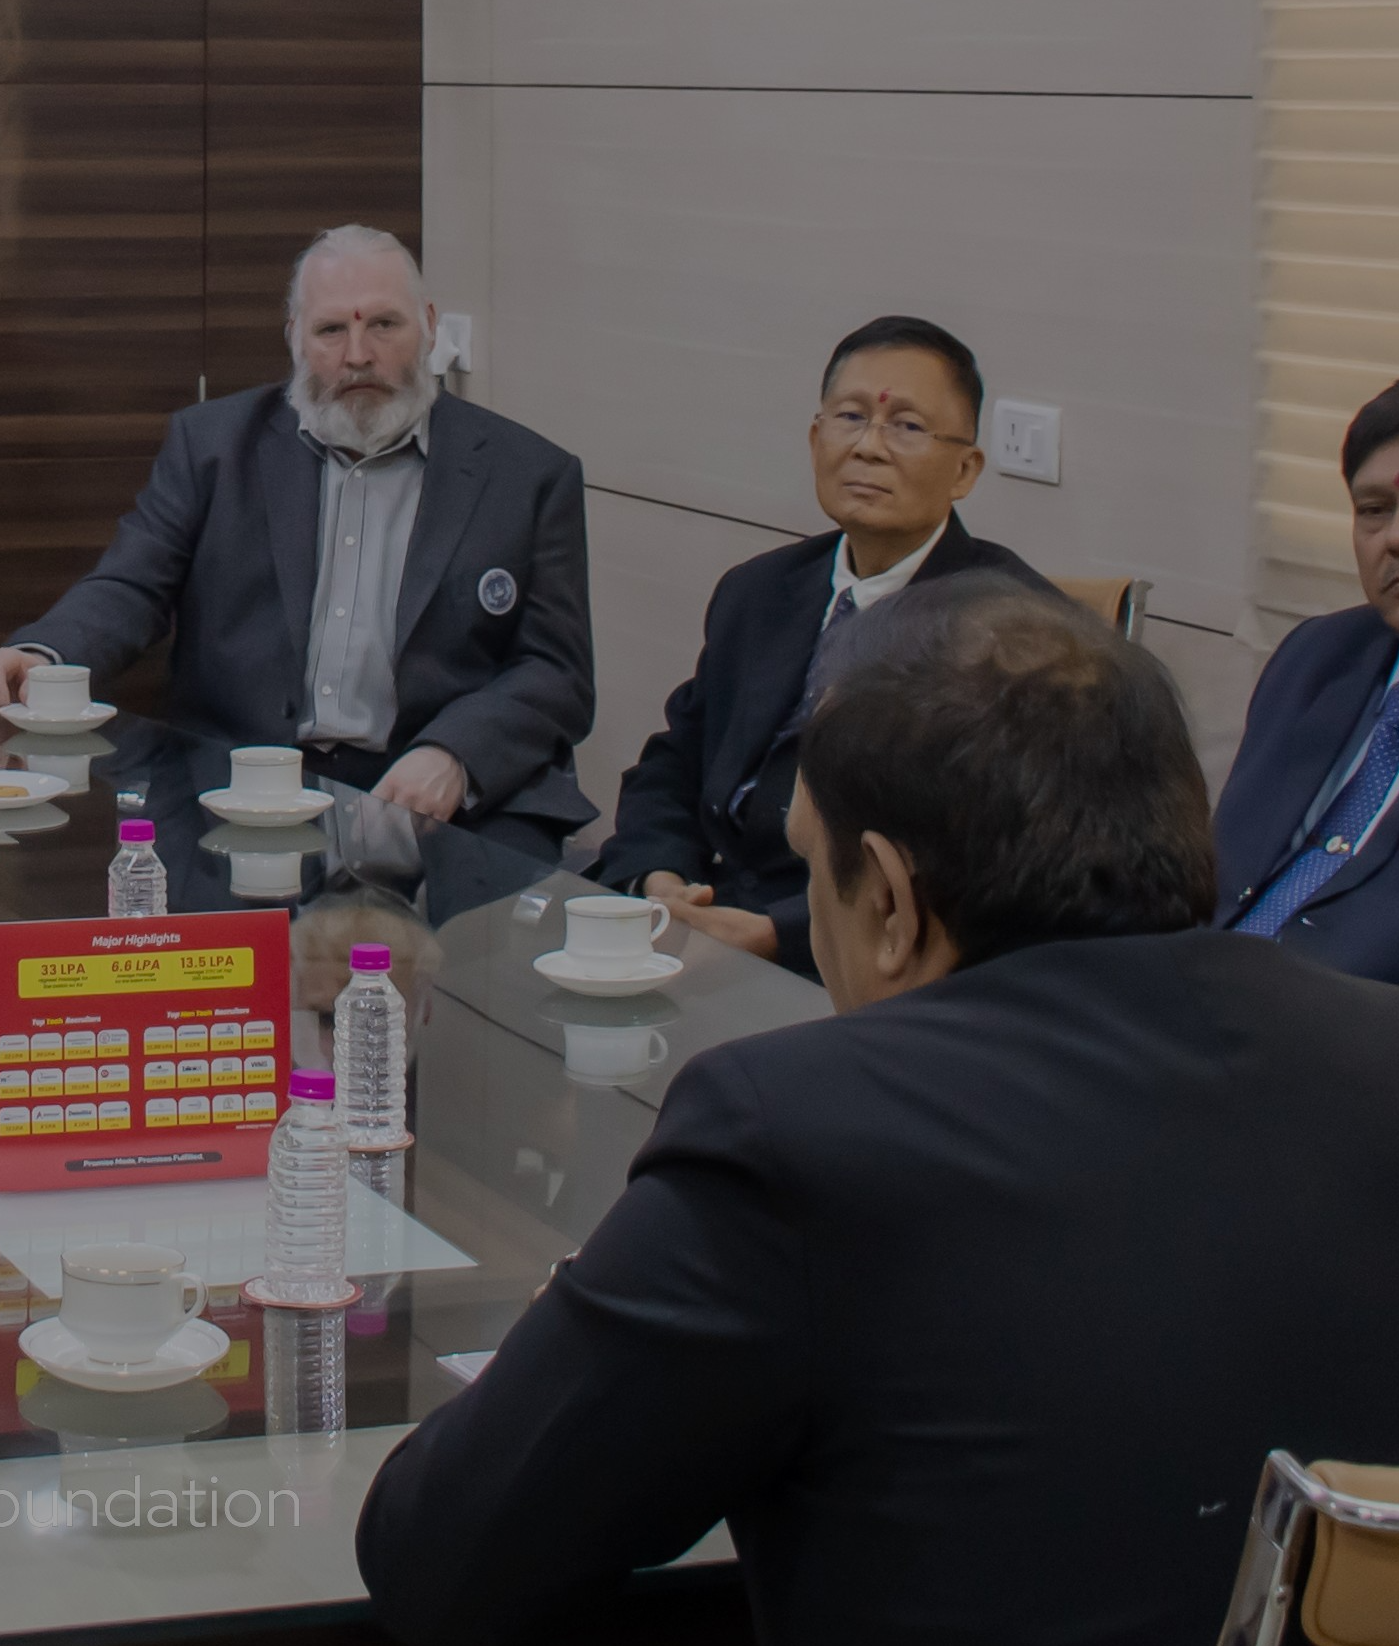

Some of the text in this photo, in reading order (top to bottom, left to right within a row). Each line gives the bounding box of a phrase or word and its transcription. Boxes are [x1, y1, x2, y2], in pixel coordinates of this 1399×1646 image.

[91, 932, 181, 949] Major Highlights
[136, 959, 161, 971] LPA
[181, 955, 235, 969] 13.5 LPA
[41, 963, 86, 976] 33 LPA
